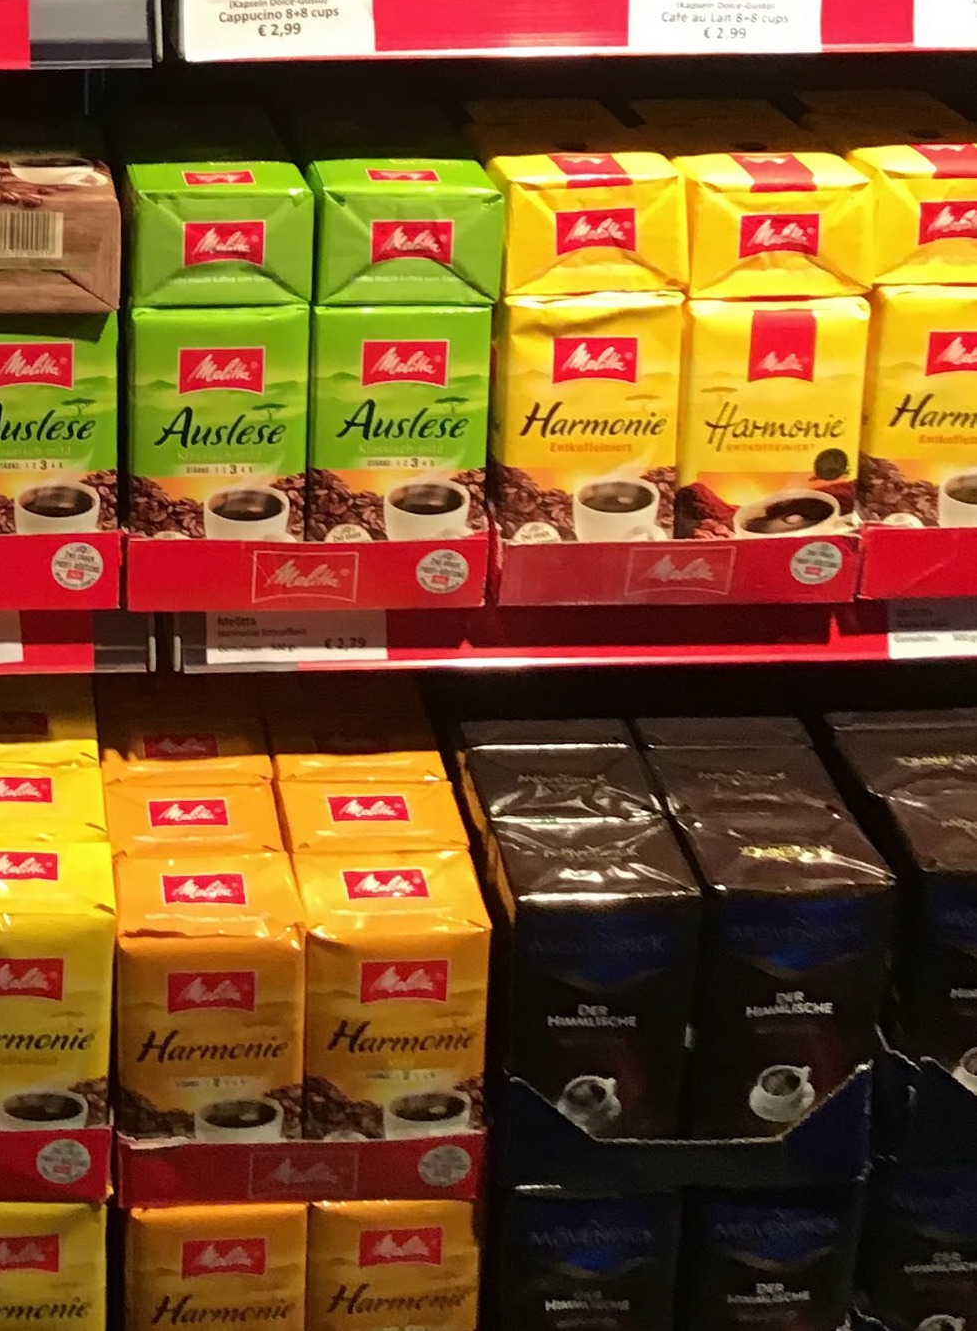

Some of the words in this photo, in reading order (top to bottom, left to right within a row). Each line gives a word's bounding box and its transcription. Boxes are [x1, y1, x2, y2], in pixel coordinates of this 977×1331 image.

[219, 10, 283, 24] Cappucino
[286, 8, 308, 19] 8+8
[311, 7, 339, 18] cups
[258, 25, 267, 36] €
[271, 23, 302, 38] 2,99
[717, 28, 747, 40] 2,99
[154, 406, 287, 449] Auslese
[336, 398, 470, 441] Auslese
[520, 402, 668, 438] Harmonie
[136, 1029, 289, 1064] Harmonie
